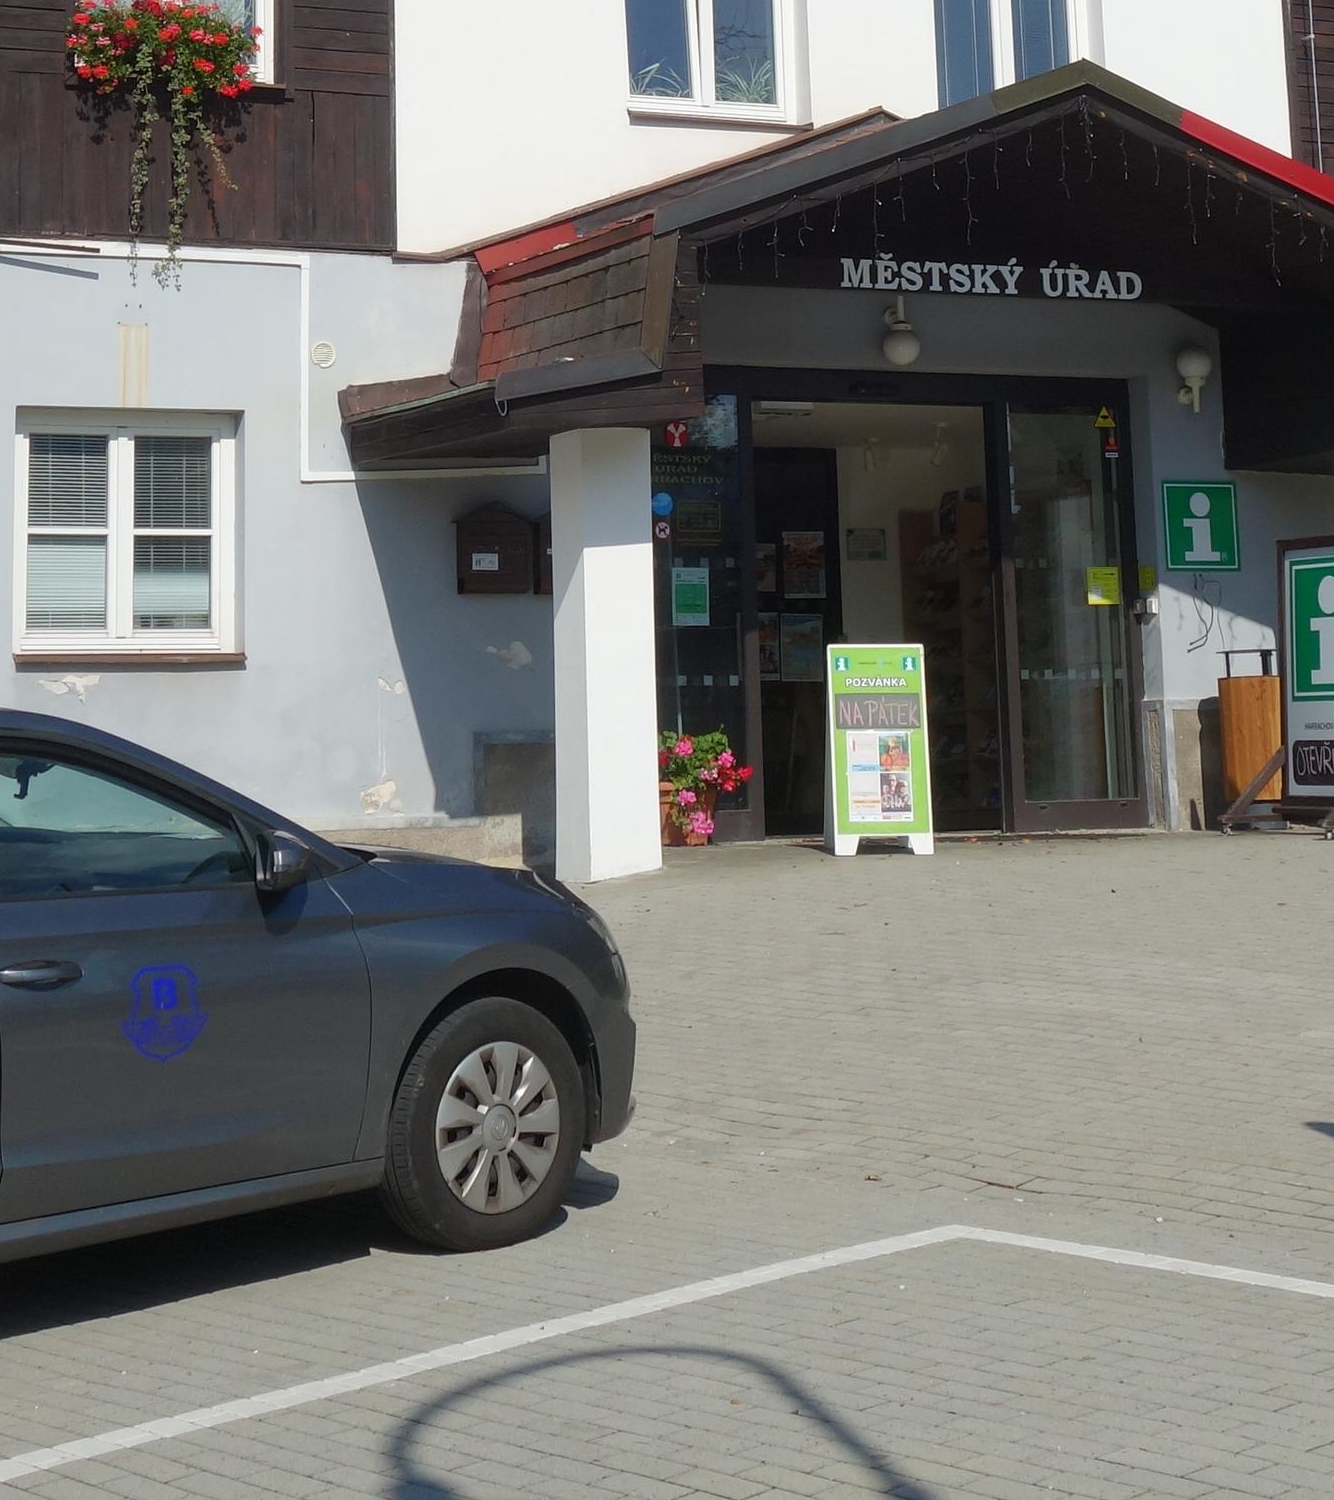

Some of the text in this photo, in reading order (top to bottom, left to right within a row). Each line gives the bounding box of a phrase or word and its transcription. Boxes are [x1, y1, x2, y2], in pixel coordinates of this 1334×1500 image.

[839, 251, 1143, 300] MĚSTSKÝ ÚŘAD
[845, 675, 907, 687] POZVÁNKA
[839, 695, 920, 727] NA PÁTEK
